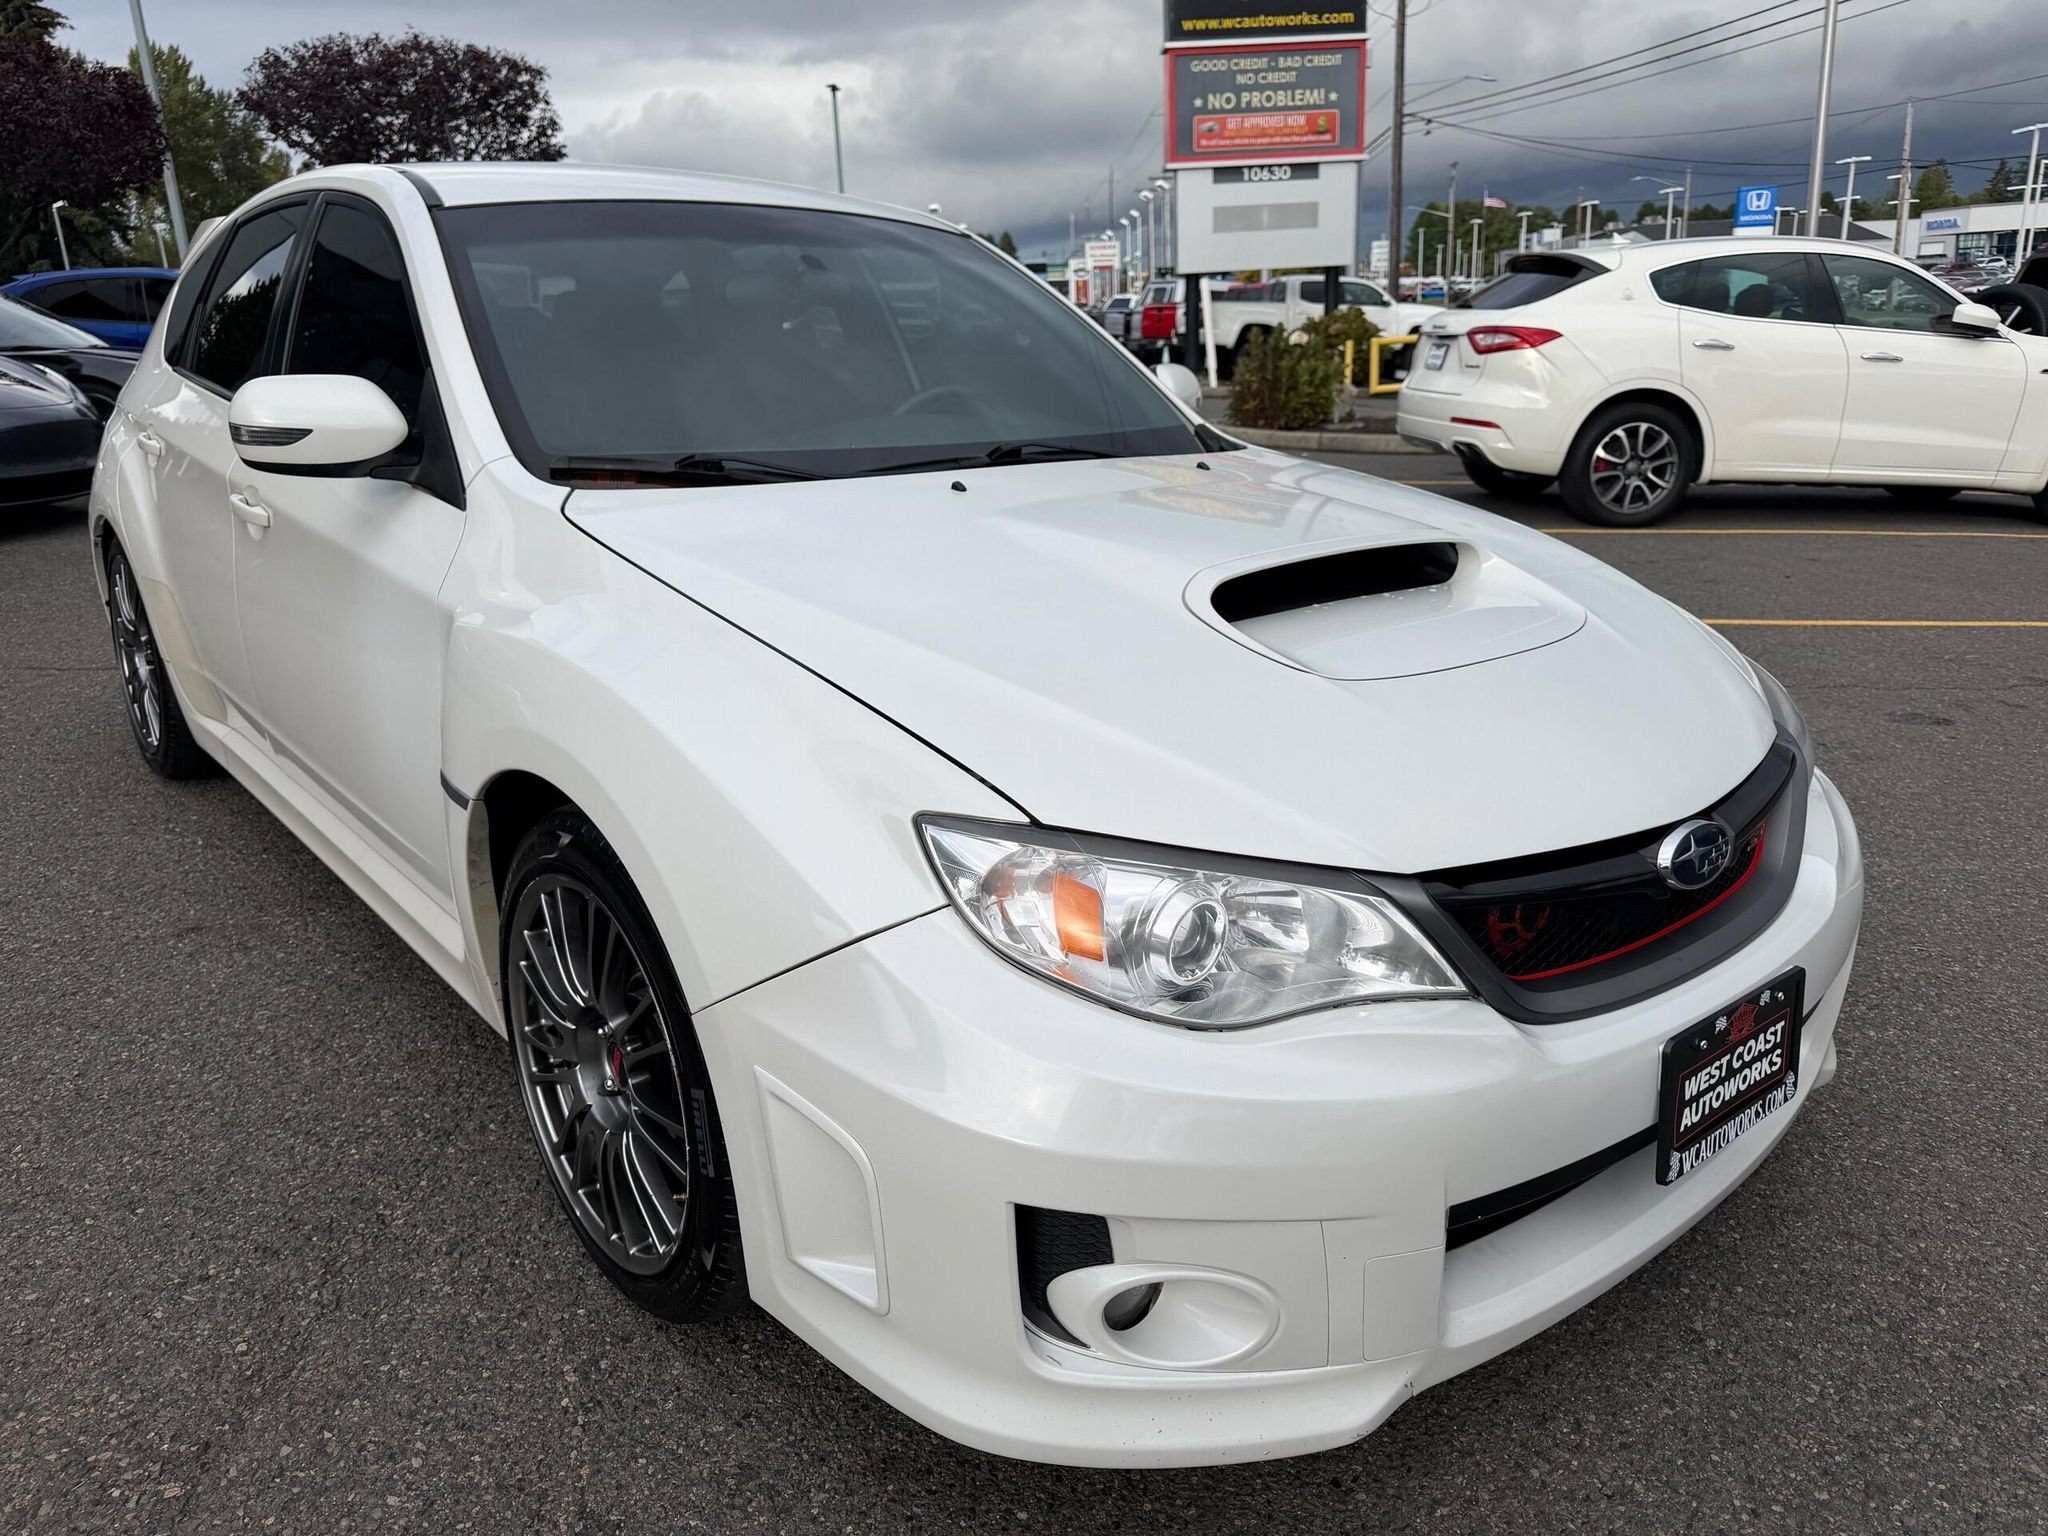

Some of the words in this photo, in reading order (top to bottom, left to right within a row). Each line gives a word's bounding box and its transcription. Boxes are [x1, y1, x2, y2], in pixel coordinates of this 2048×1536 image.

[1181, 11, 1355, 31] www.wcautoworks.com
[1190, 59, 1228, 72] GOOD
[1230, 57, 1269, 70] CREDIT
[1278, 56, 1301, 68] BAD
[1304, 54, 1342, 67] CREDIT
[1236, 73, 1255, 84] NO
[1257, 71, 1297, 84] CREDIT
[1207, 92, 1236, 110] NO
[1240, 88, 1326, 108] PROBLEM!
[1241, 165, 1292, 182] 10630
[1684, 1053, 1731, 1100] WEST
[1732, 1020, 1785, 1069] COAST
[1680, 1048, 1782, 1132] AUTOWORKS
[1682, 1084, 1786, 1174] WCAUTOWORKS.COM
